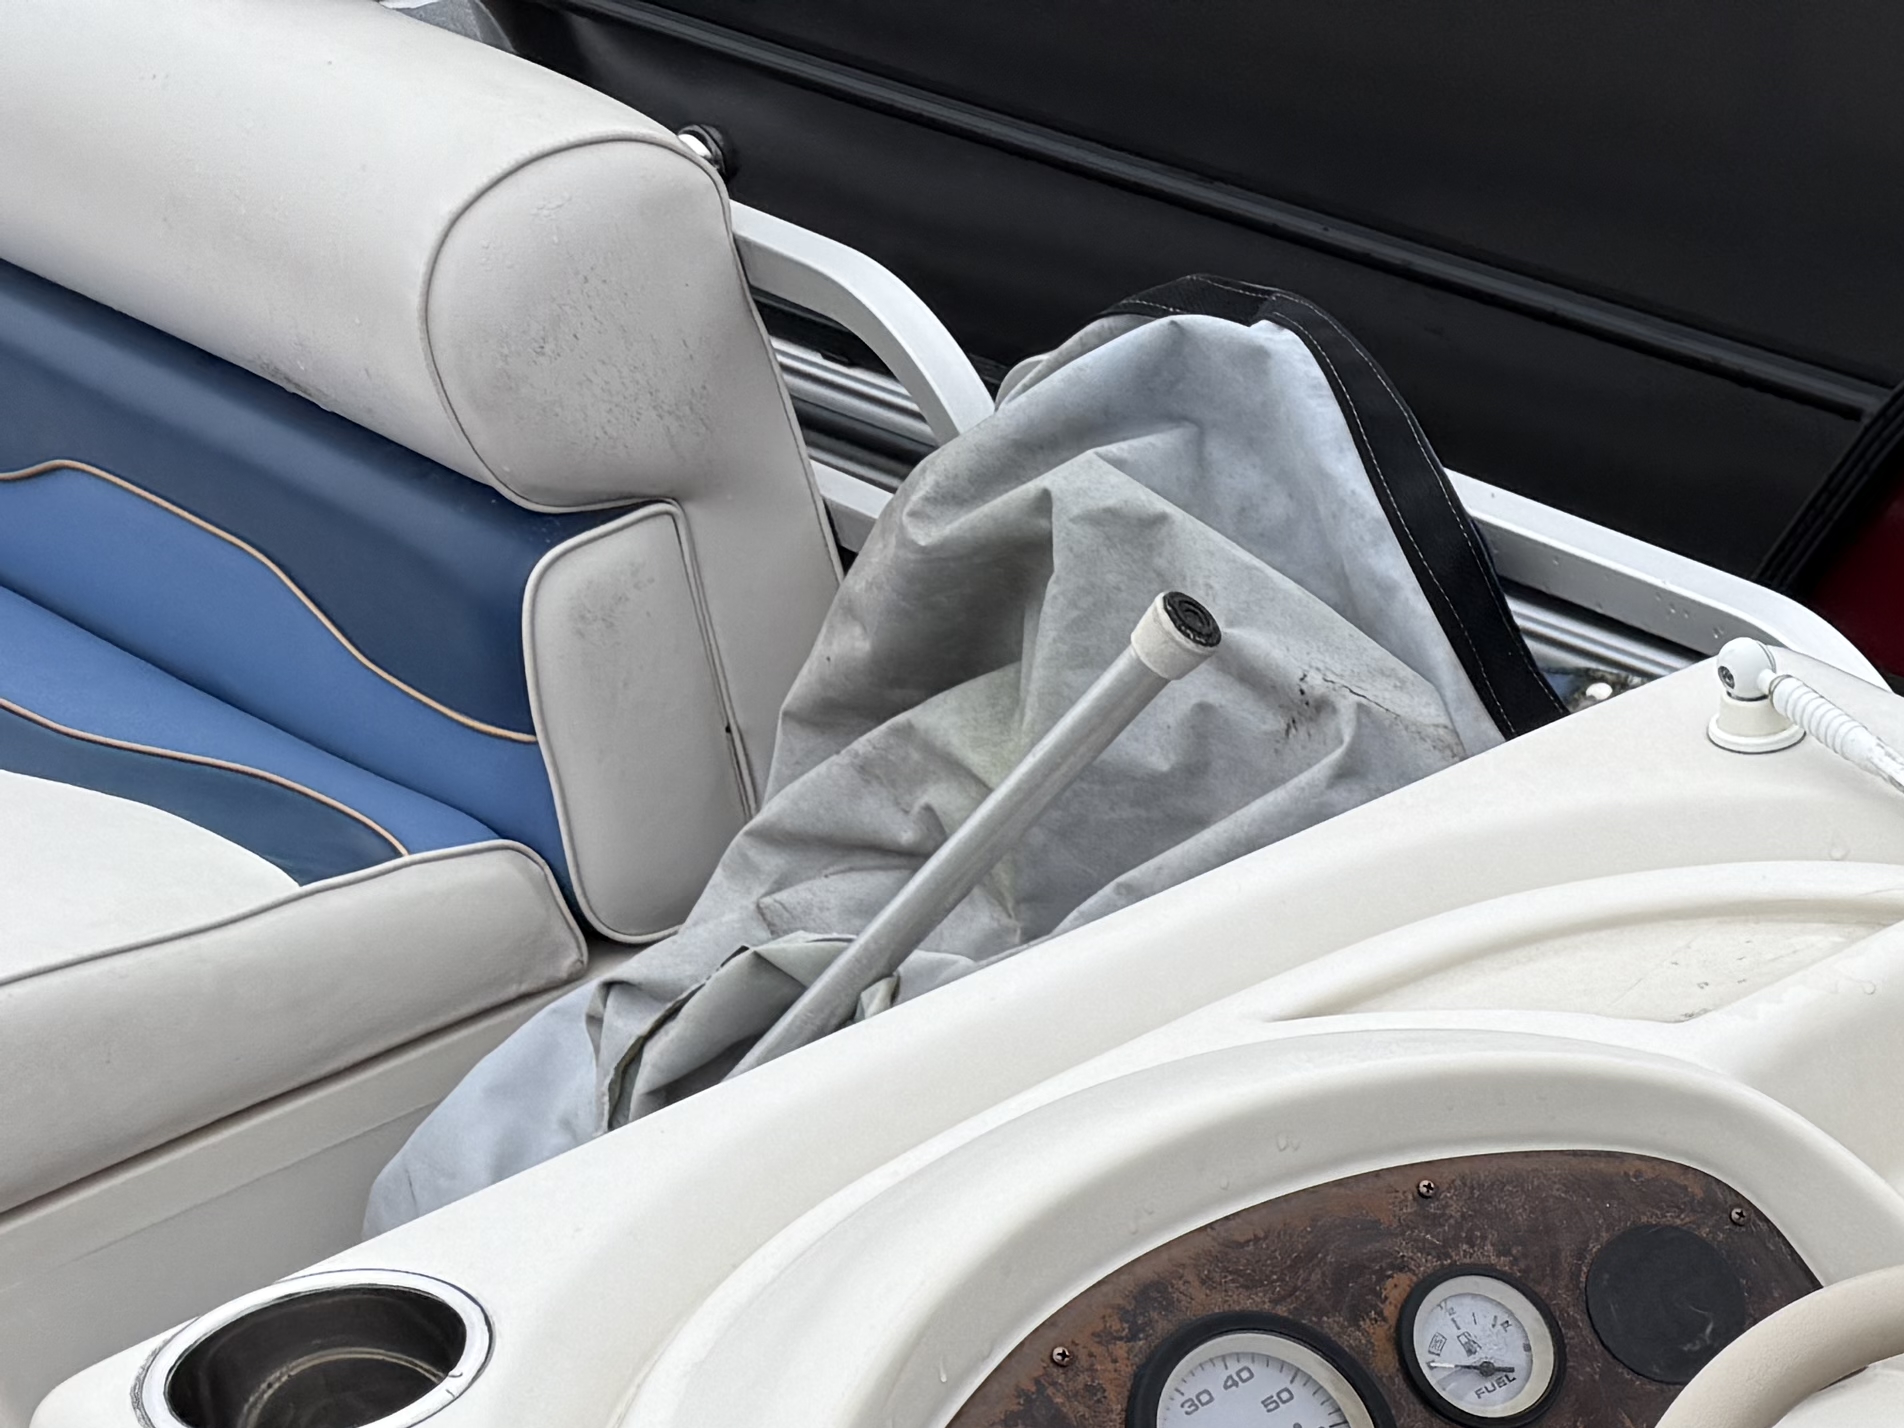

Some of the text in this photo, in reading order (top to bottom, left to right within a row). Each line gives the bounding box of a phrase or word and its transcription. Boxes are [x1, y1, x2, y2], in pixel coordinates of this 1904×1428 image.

[1223, 1366, 1255, 1391] 40
[1474, 1372, 1517, 1399] FUEL
[1180, 1389, 1215, 1416] 30
[1260, 1387, 1295, 1413] 50
